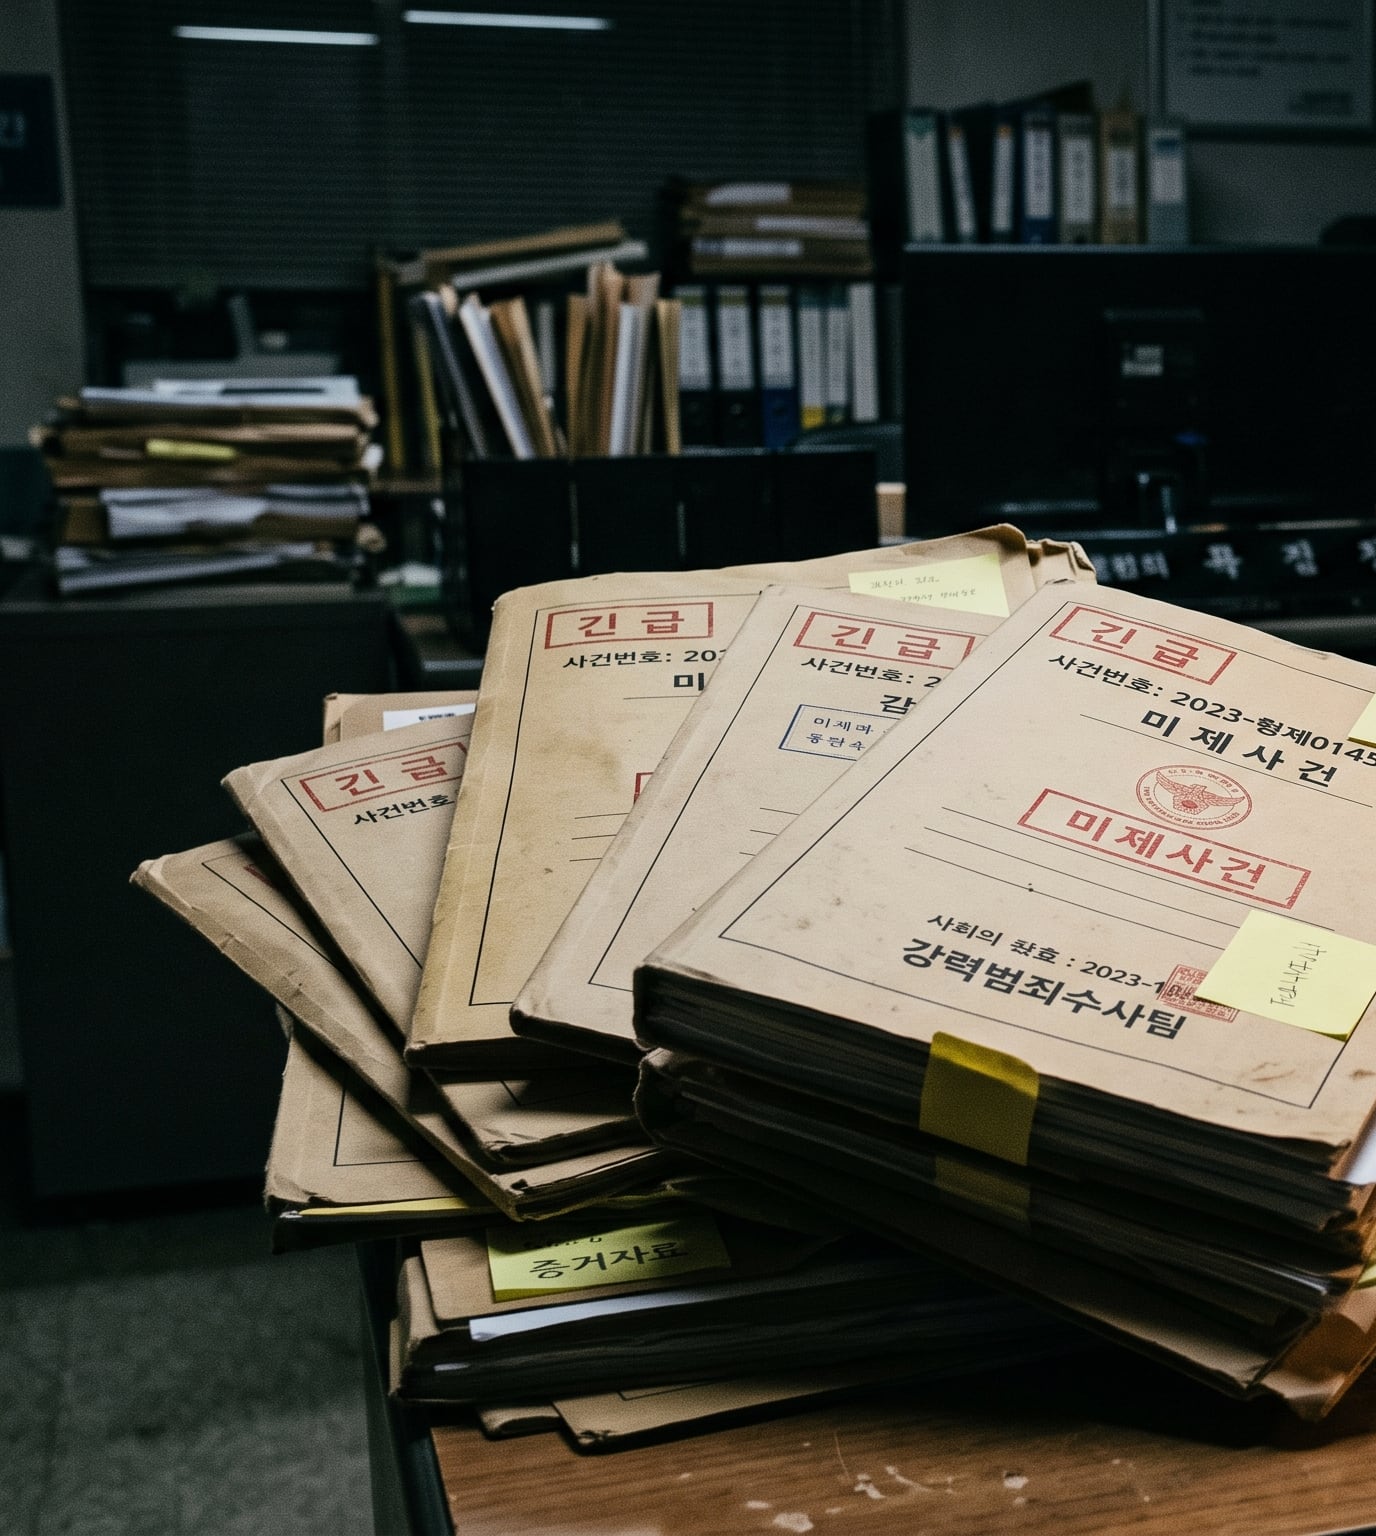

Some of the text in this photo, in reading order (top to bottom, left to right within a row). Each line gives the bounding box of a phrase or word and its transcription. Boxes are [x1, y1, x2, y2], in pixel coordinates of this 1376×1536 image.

[562, 650, 672, 668] 사건번호:
[801, 657, 913, 684] 사건번호:
[674, 672, 705, 691] 미
[1048, 653, 1163, 698] 사건번호:
[1066, 809, 1266, 890] 미제사건
[928, 915, 1003, 946] 사회의
[902, 938, 1188, 1040] 강력범죄수사팀
